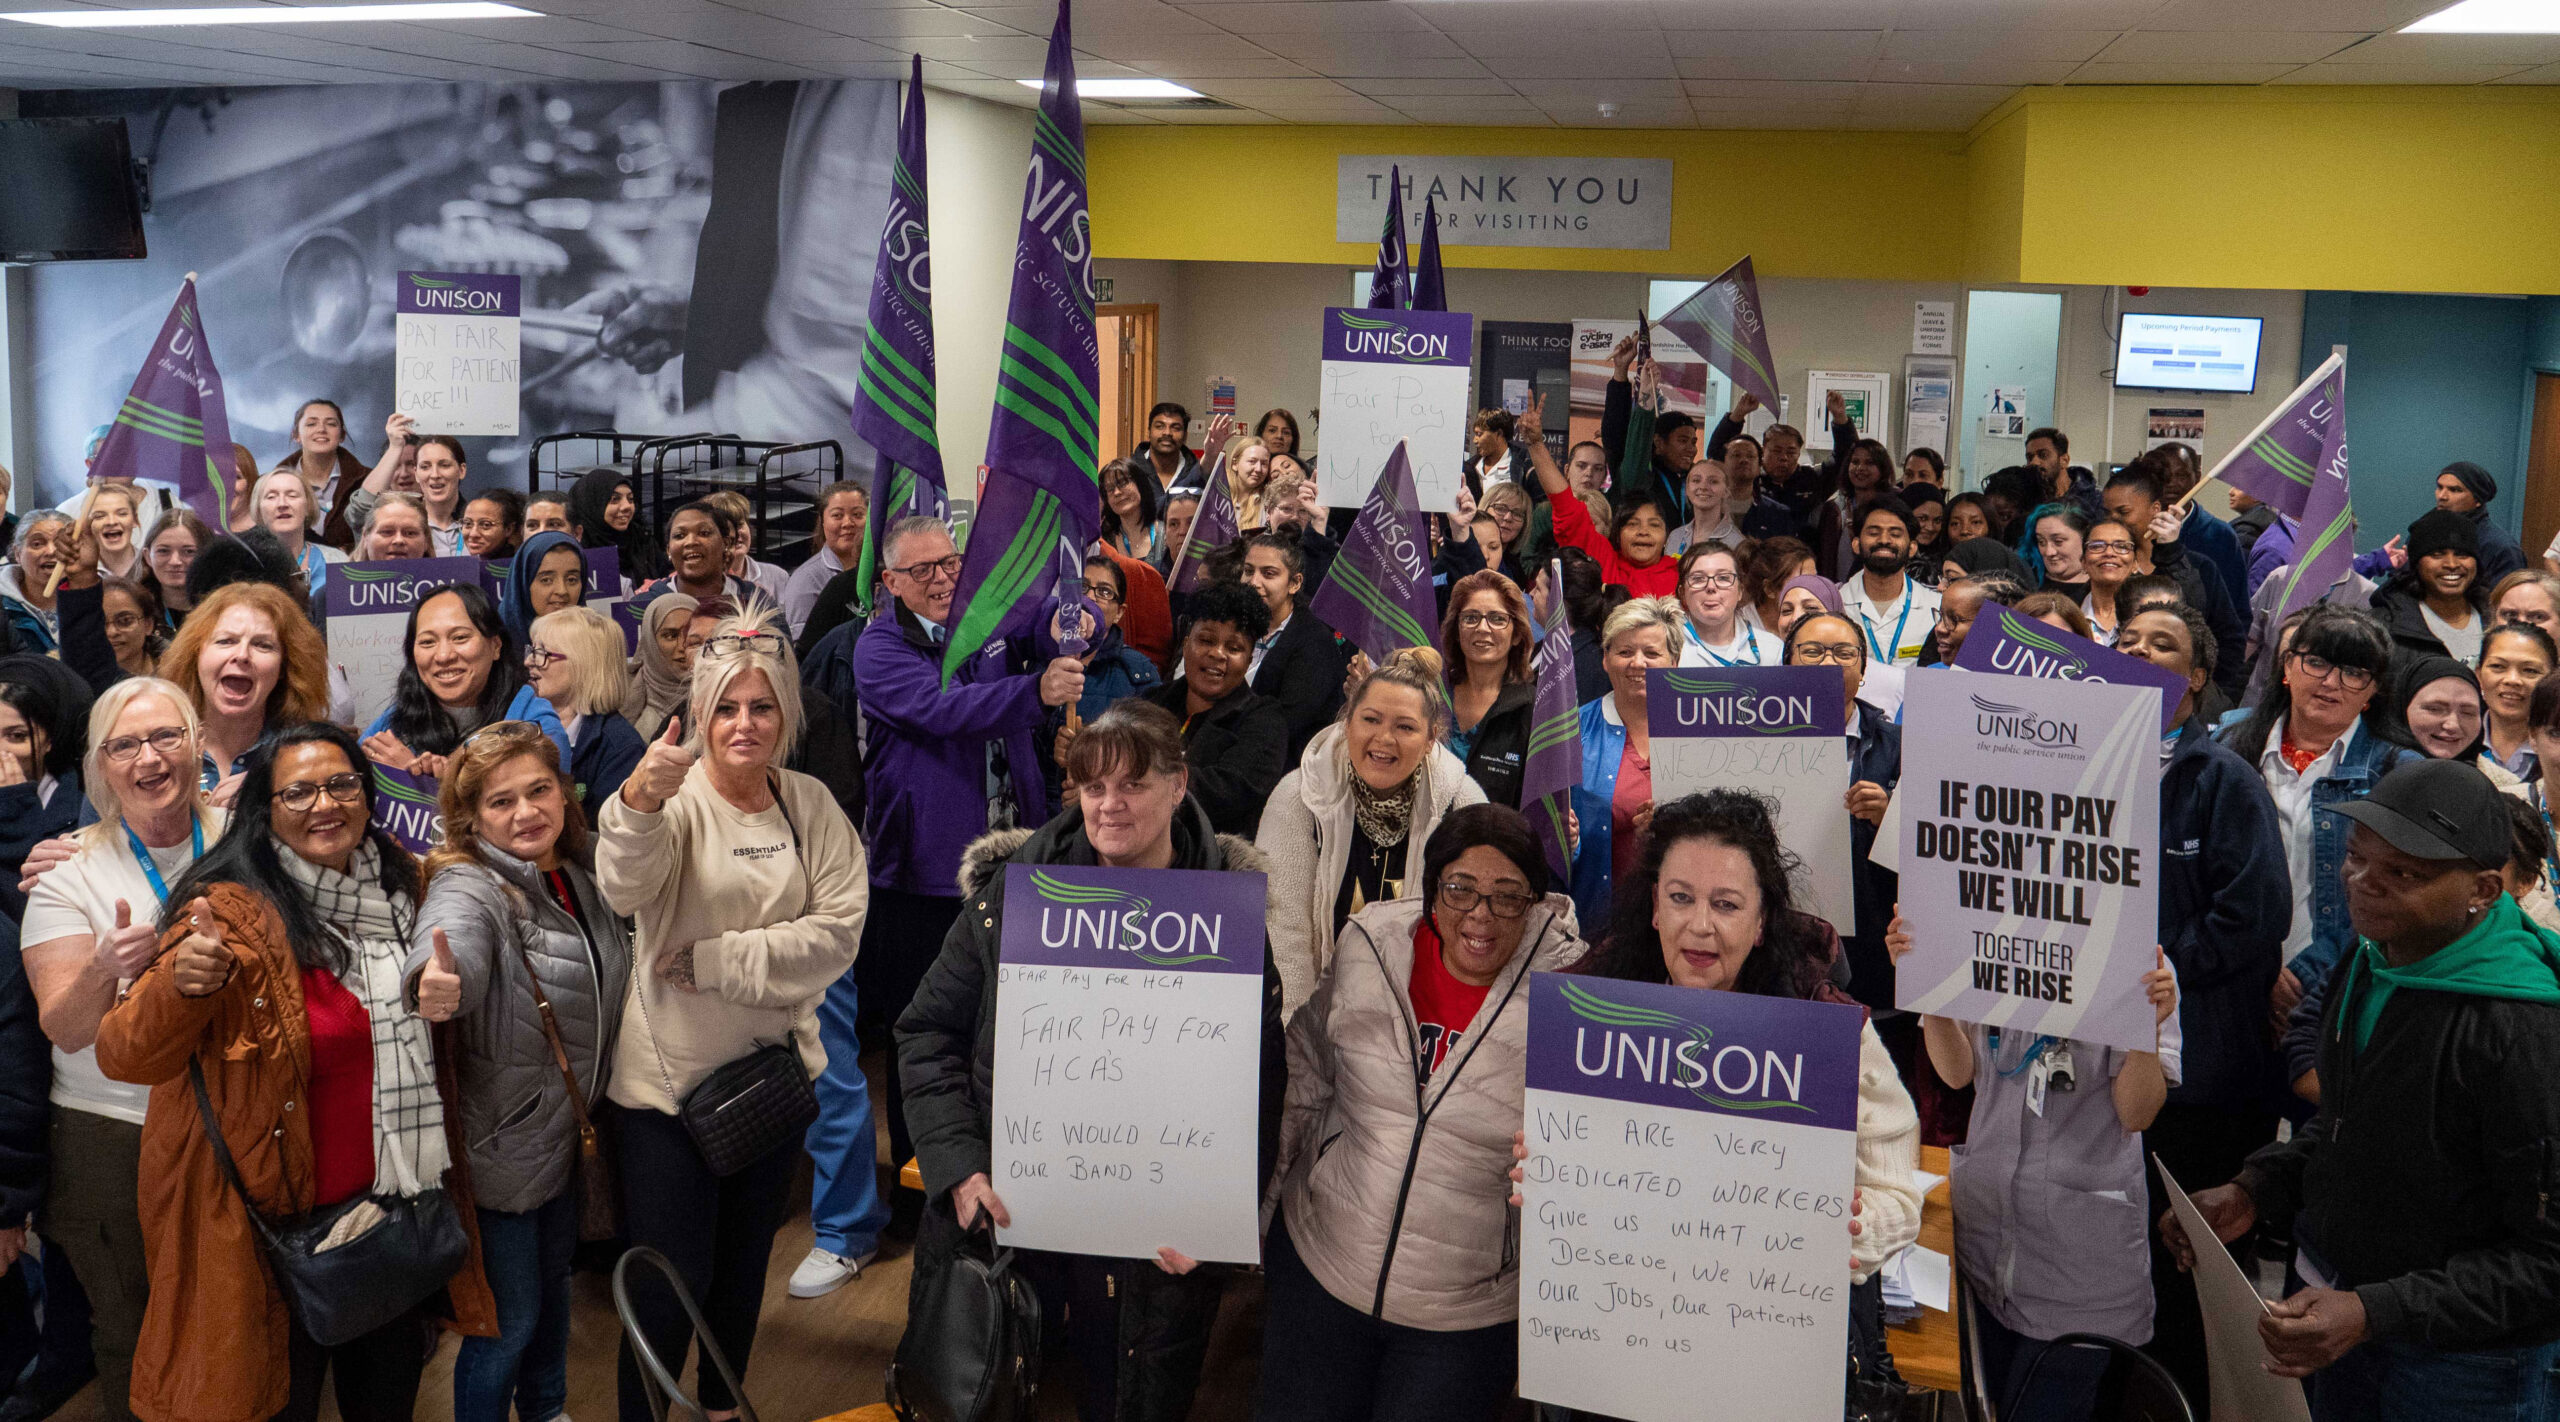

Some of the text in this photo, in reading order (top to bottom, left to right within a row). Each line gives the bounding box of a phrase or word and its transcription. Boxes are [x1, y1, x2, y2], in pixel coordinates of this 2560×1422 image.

[1547, 176, 1640, 206] YOU
[1475, 213, 1590, 231] VISITING
[416, 288, 501, 309] UNISON
[1033, 271, 1086, 334] service
[1723, 279, 1760, 333] UNISON
[404, 321, 507, 351] PAY FAIR
[1345, 330, 1448, 357] UNISON
[1501, 335, 1571, 348] THINK FOO
[1580, 331, 1613, 343] cycling
[2140, 323, 2241, 334] Upcoming Period Payments
[402, 356, 519, 383] FOR PATIENT
[400, 390, 443, 411] CARE
[1392, 375, 1445, 434] Pay
[1370, 542, 1393, 575] service
[1390, 574, 1412, 600] union
[1676, 695, 1812, 725] UNISON
[1976, 713, 2078, 745] UNISON
[1505, 752, 1520, 761] NHS
[1652, 738, 1833, 781] WE DESERVE
[1977, 741, 2086, 761] the public service union
[1940, 780, 2116, 838] IF OUR PAY
[733, 842, 787, 857] ESSENTIALS
[1916, 820, 2141, 888] DOESN'T RISE
[2184, 838, 2200, 850] NHS
[1958, 869, 2091, 926] WE WILL
[1040, 907, 1222, 954] UNISON
[1972, 930, 2073, 972] TOGETHER
[1105, 973, 1129, 986] FOR
[1144, 976, 1183, 990] HCA
[1972, 960, 2073, 1005] WE RISE
[1020, 1003, 1230, 1050] FAIR PAY FOR
[1576, 1027, 1803, 1101] UNISON
[1005, 1115, 1042, 1145] WE
[1062, 1121, 1139, 1145] WOULD
[1537, 1107, 1588, 1143] WE
[1625, 1119, 1675, 1147] ARE
[1010, 1156, 1164, 1184] OUR BAND 3
[1528, 1155, 1844, 1218] DEDICATED WORKERS
[1671, 1221, 1746, 1246] WHAT
[1528, 1317, 1601, 1345] Depends
